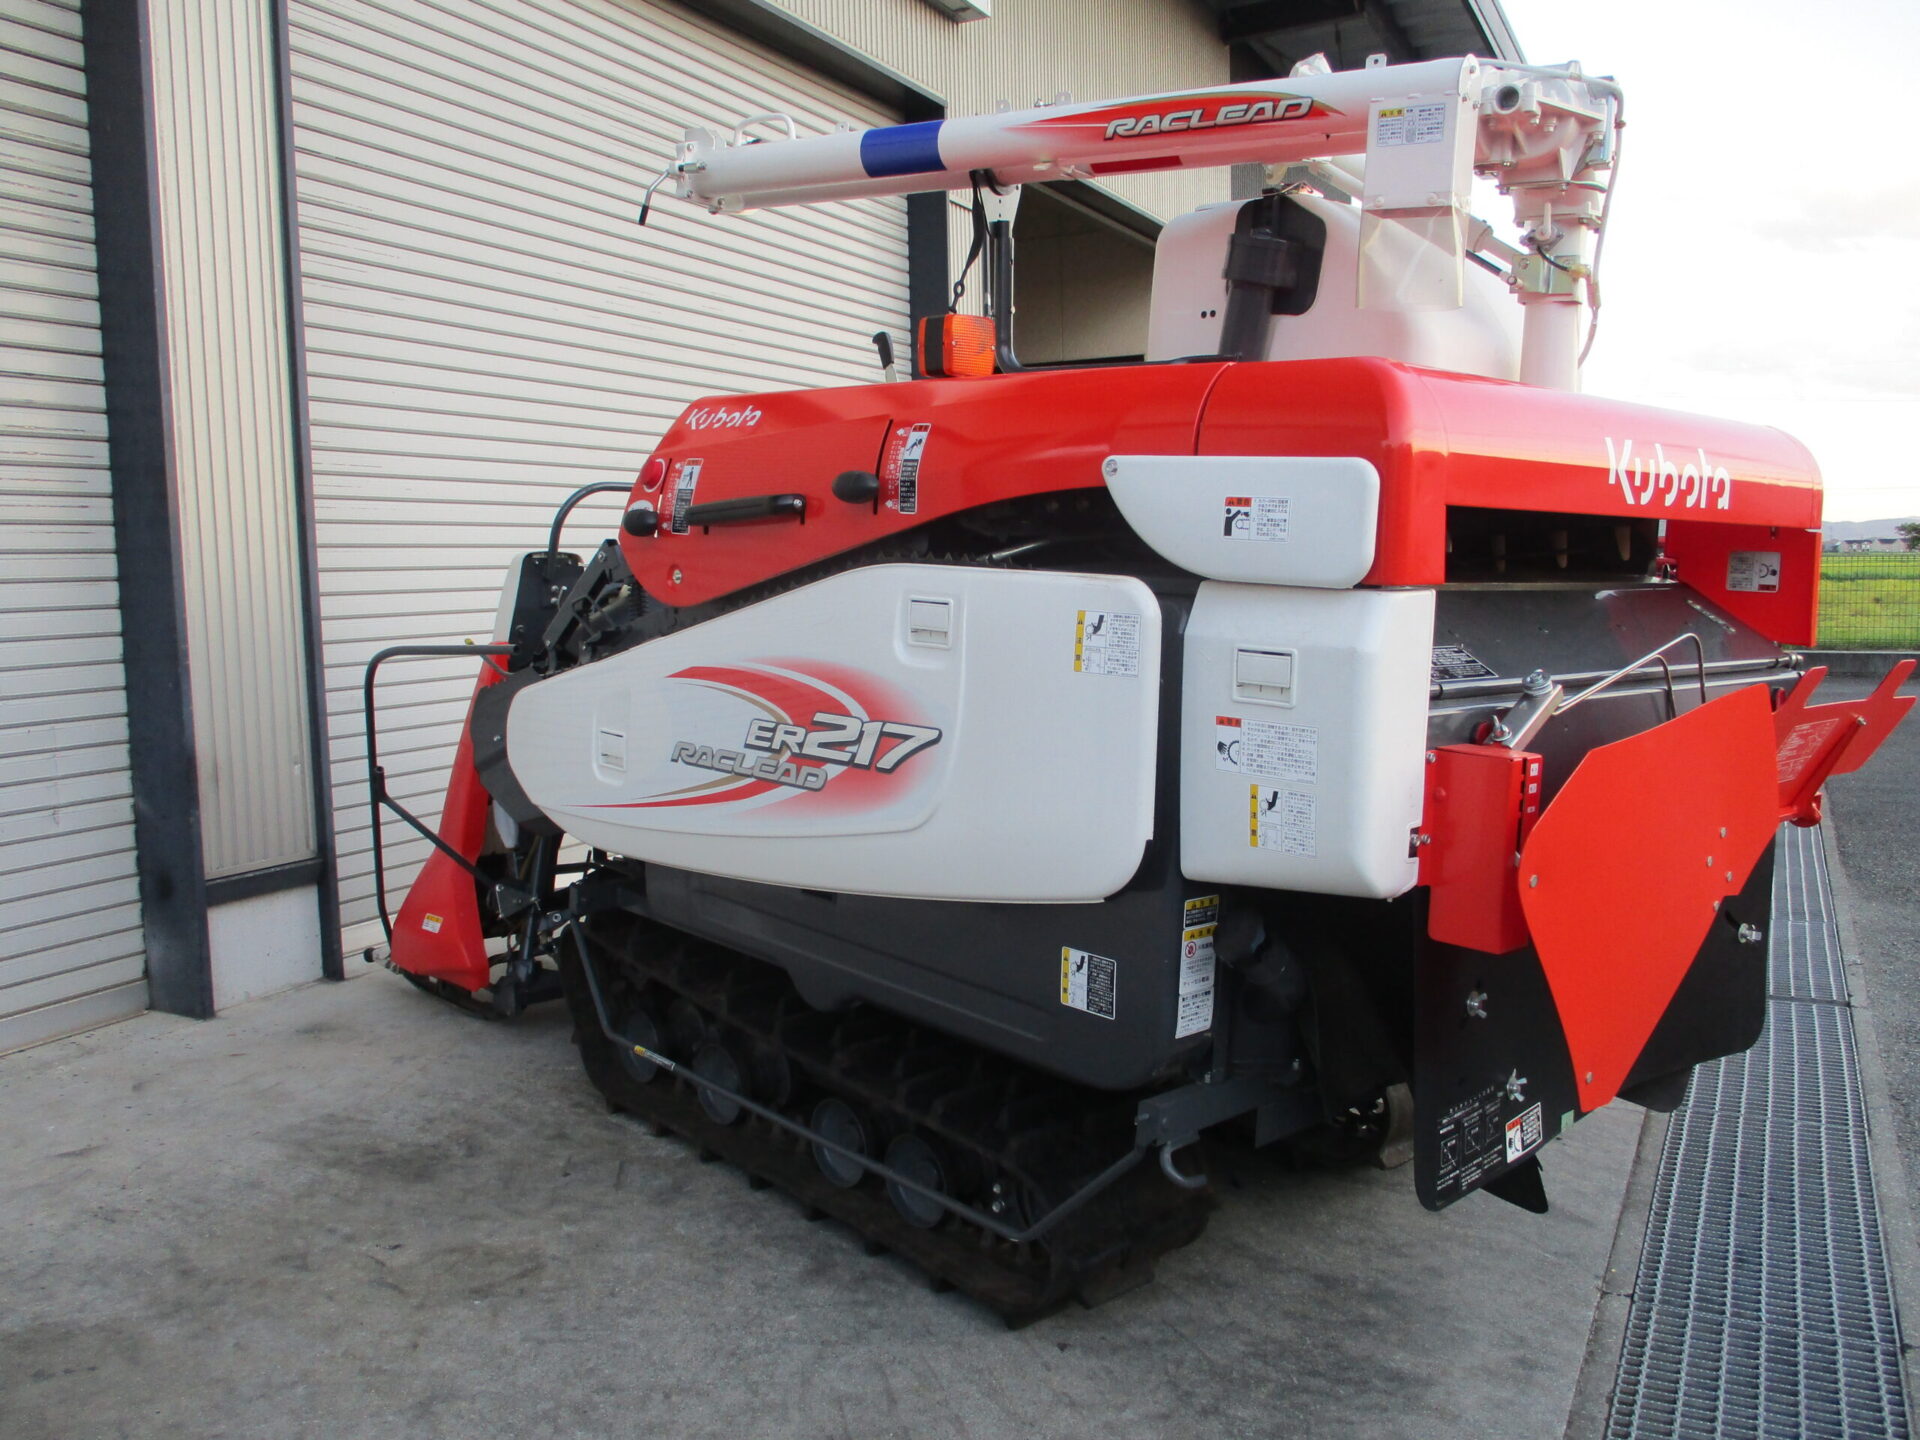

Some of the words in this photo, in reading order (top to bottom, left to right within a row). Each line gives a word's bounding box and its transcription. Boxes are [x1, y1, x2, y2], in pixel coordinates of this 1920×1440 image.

[1104, 97, 1314, 141] RACLEAD
[684, 405, 762, 430] Kubota
[1604, 436, 1731, 510] Kubota
[671, 741, 828, 792] RACLEAD
[744, 711, 943, 774] ER217
